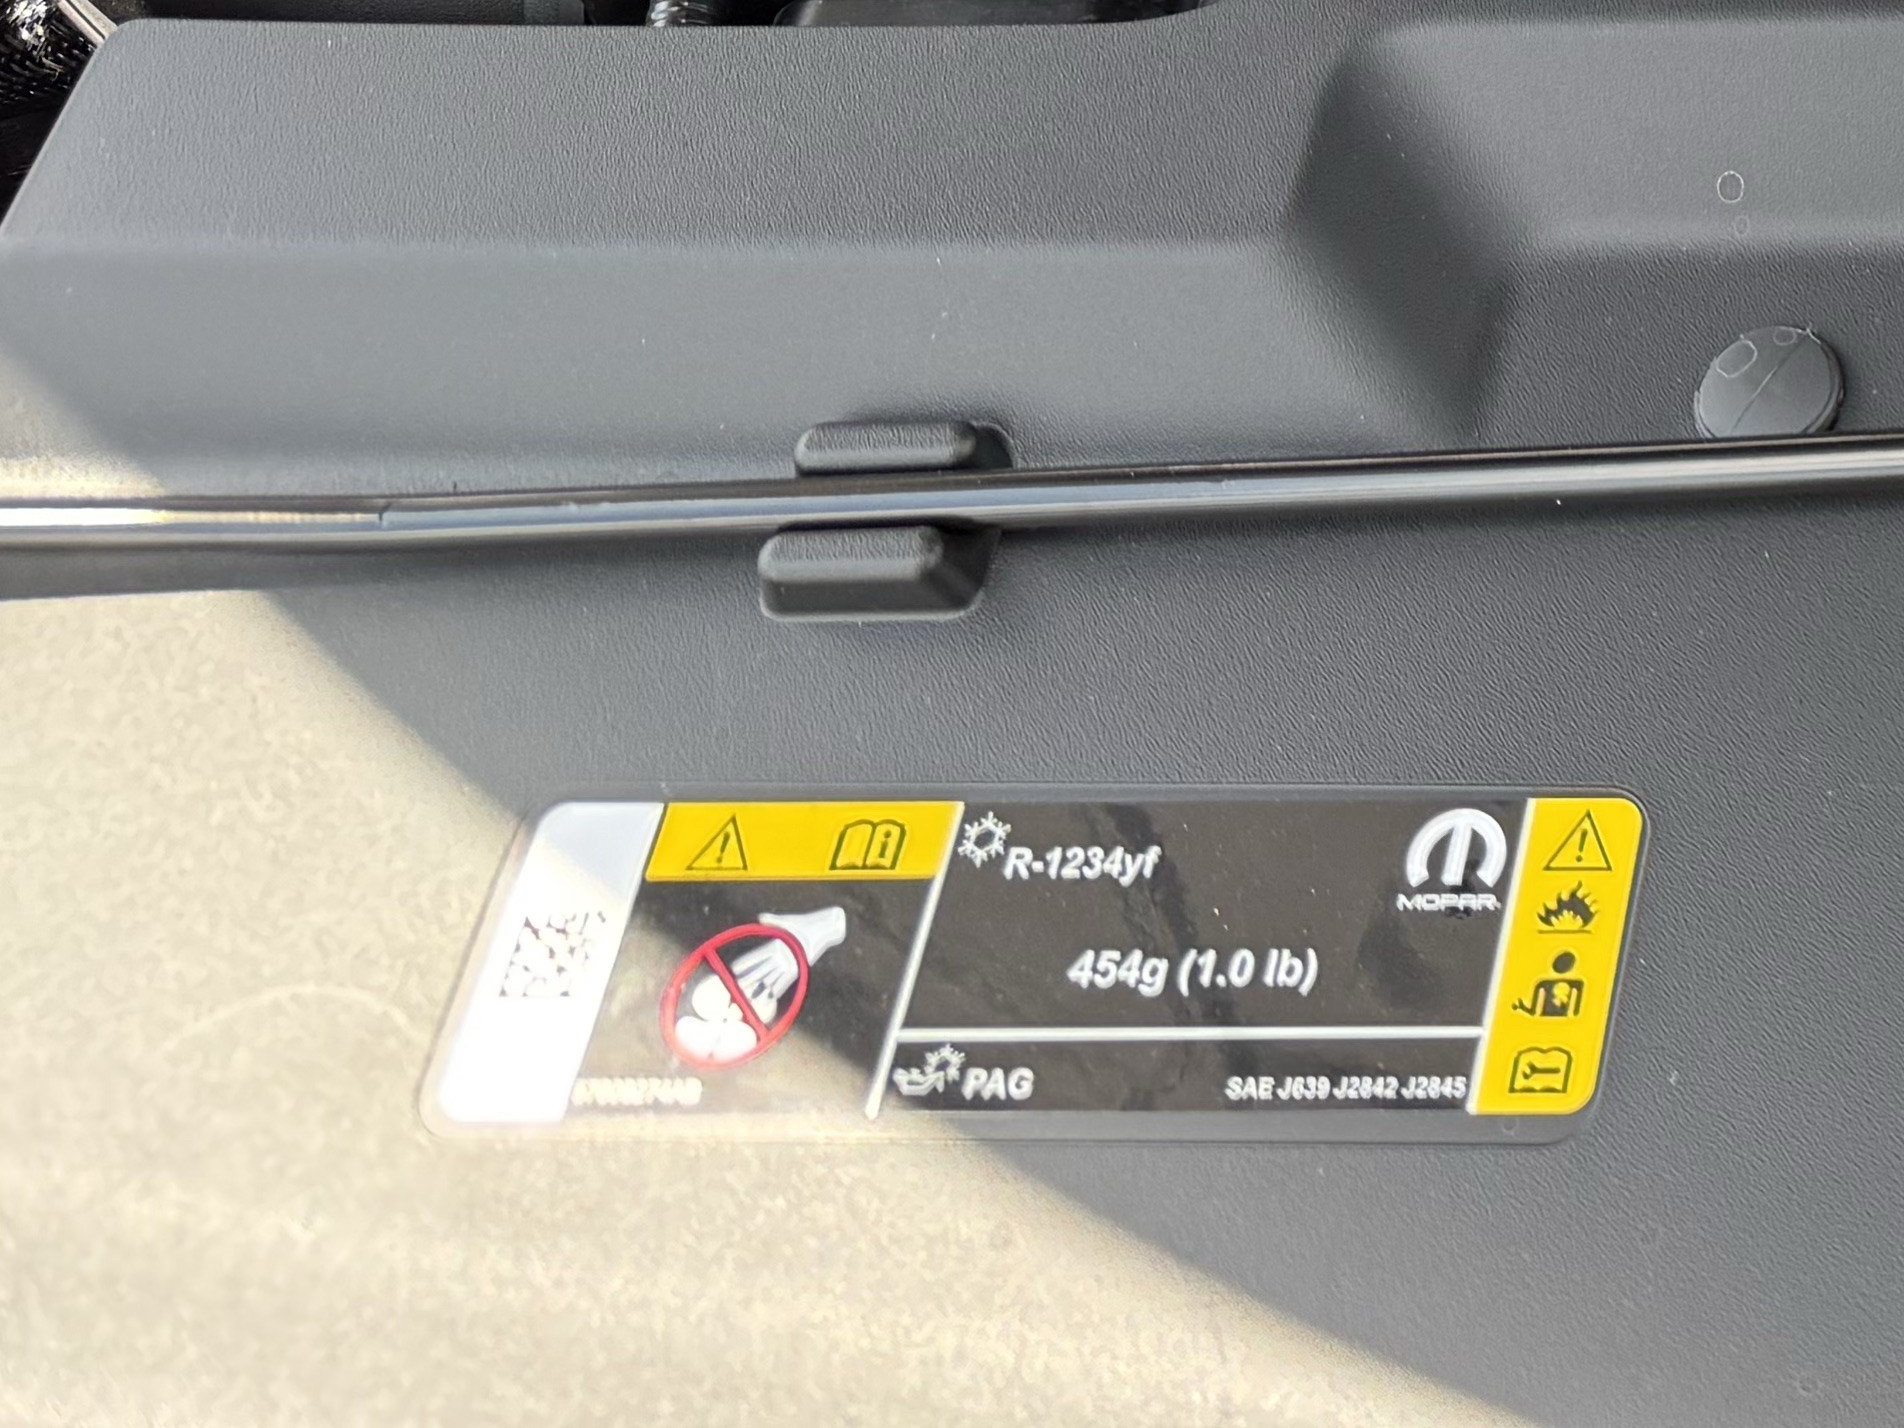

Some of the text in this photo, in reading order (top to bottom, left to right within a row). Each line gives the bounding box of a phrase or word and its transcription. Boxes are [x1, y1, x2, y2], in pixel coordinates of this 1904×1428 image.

[1003, 845, 1160, 887] R-1234yf
[1396, 894, 1502, 913] MOPAR
[1068, 947, 1319, 997] 454g (1.0 lb)
[963, 1067, 1467, 1101] PAG SAE J639 J2842 J2845
